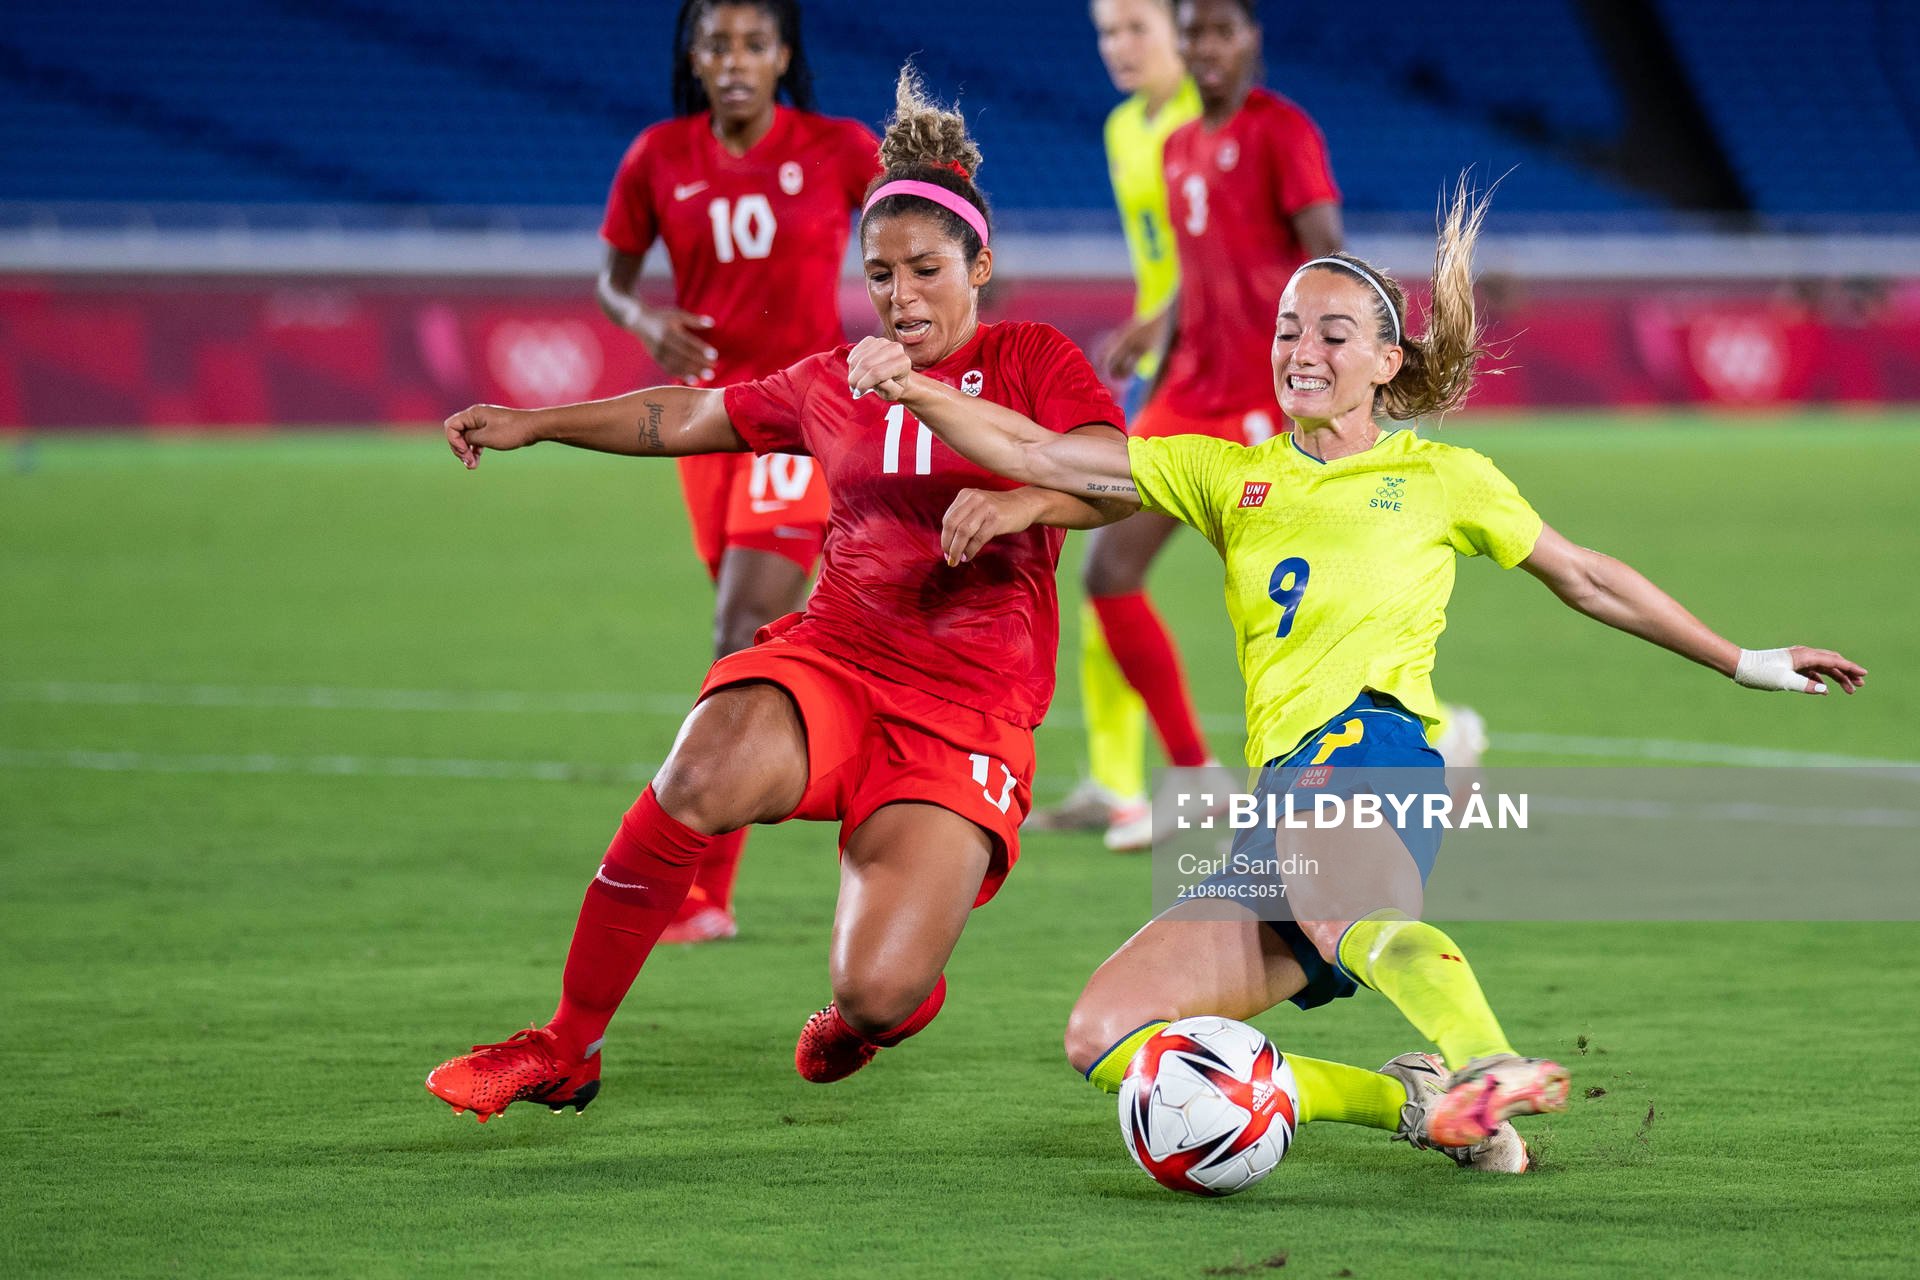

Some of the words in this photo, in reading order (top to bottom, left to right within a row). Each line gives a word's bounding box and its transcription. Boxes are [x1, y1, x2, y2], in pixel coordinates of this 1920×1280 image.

[1182, 173, 1208, 236] 3
[708, 193, 777, 263] 10
[883, 404, 932, 475] 11
[748, 453, 813, 500] 10
[1087, 483, 1108, 492] Stay
[1246, 485, 1266, 495] UNI
[1242, 496, 1262, 506] QLO
[1369, 498, 1402, 511] SWE
[1268, 557, 1310, 637] 9
[1306, 769, 1327, 778] UNI
[1301, 777, 1325, 786] QLO
